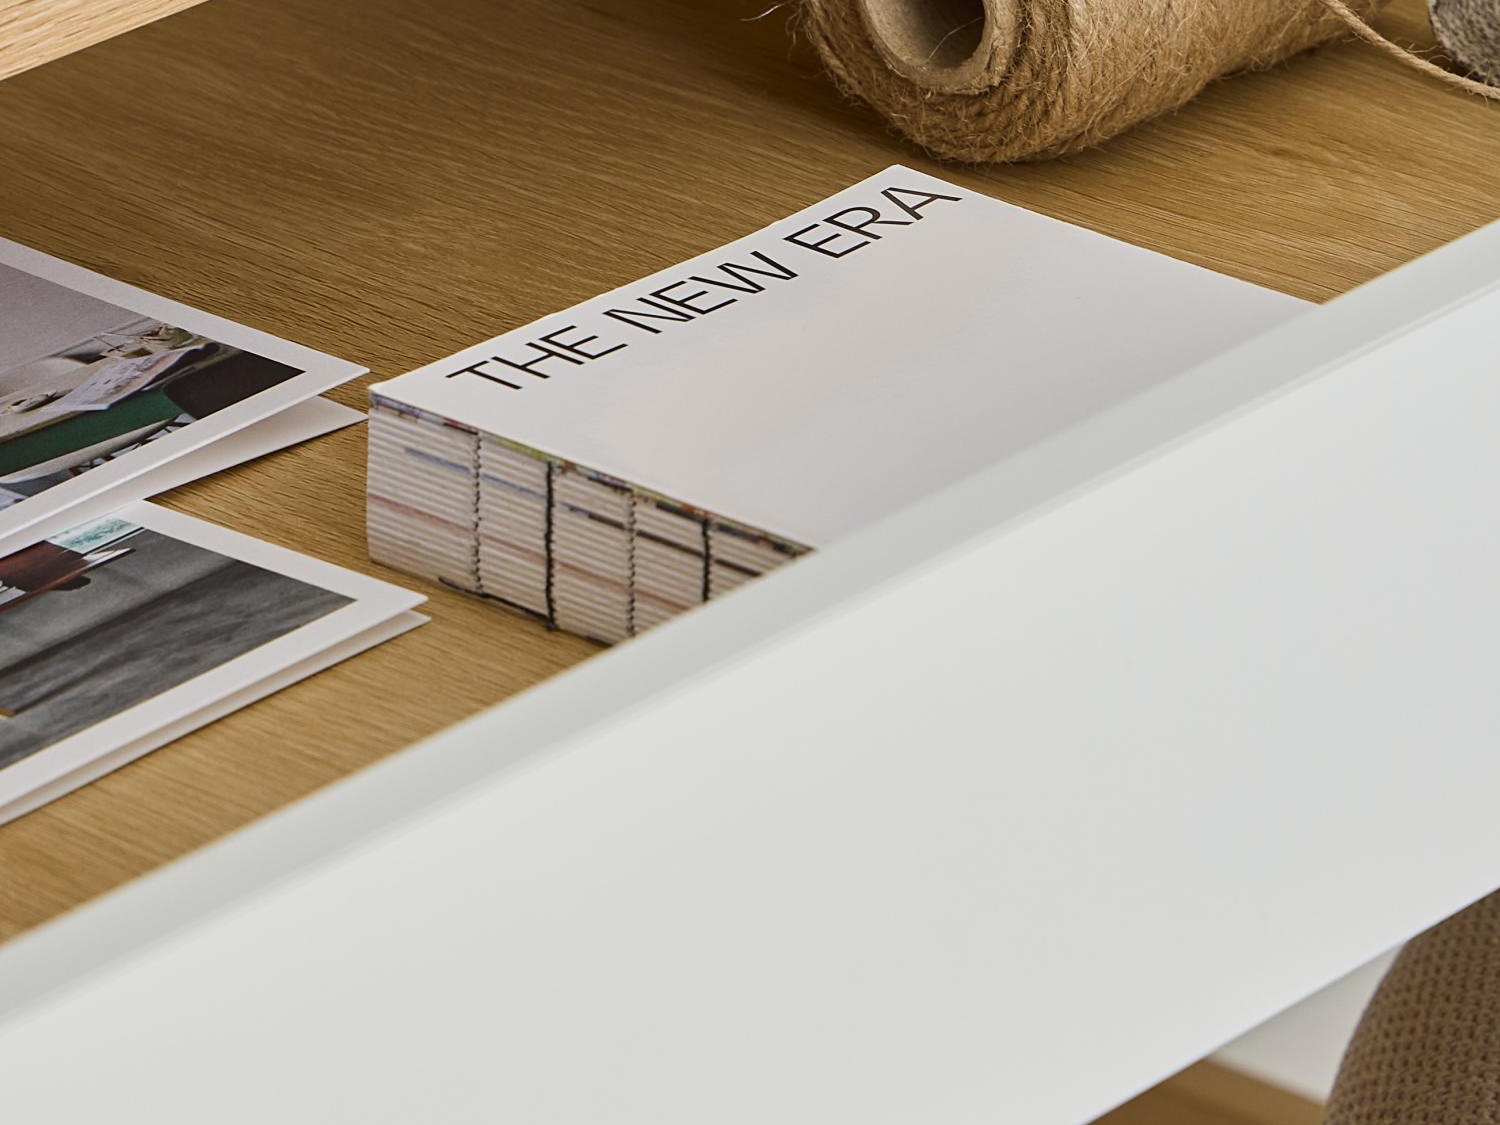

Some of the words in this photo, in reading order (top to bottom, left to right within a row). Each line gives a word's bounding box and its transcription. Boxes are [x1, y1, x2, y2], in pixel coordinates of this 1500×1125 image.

[443, 324, 630, 391] THE
[601, 249, 800, 335] NEW
[782, 185, 964, 260] ERA
